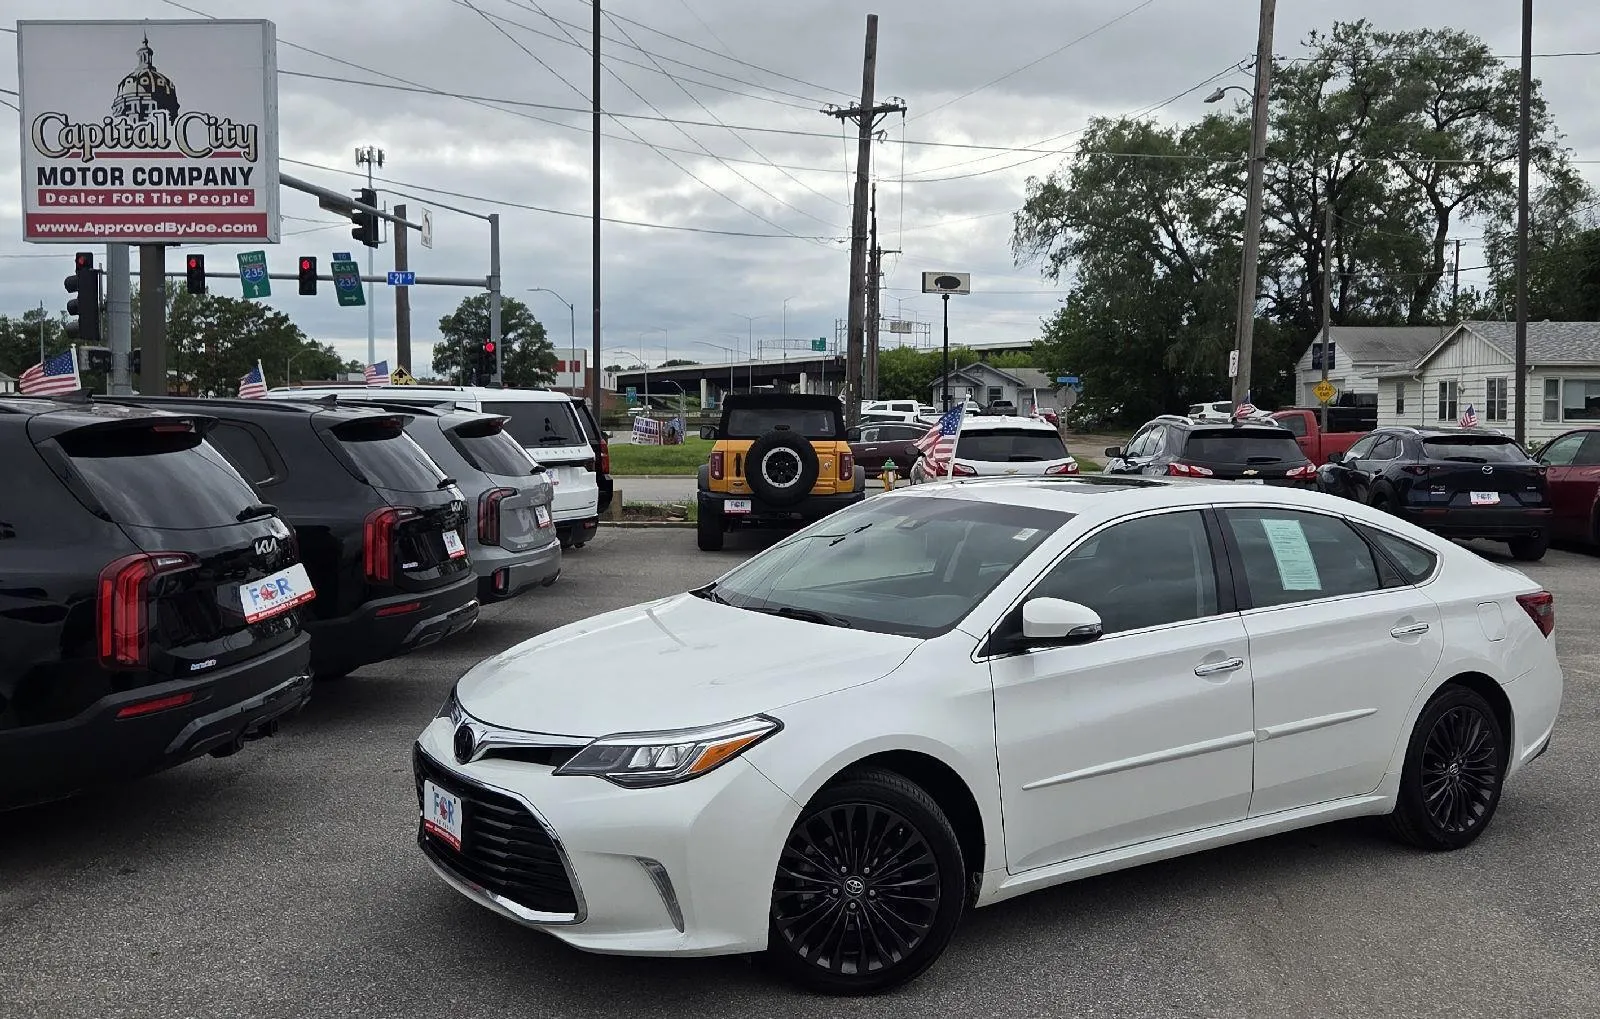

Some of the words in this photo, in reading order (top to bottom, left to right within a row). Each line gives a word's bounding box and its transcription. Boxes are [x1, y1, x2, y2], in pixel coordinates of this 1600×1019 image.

[32, 111, 171, 163] Capital
[175, 111, 258, 162] City
[37, 166, 124, 186] MOTOR
[132, 166, 254, 186] COMPANY
[45, 192, 105, 204] Dealer
[112, 193, 145, 204] FOR
[150, 193, 182, 204] The
[188, 192, 249, 206] People
[35, 222, 258, 235] www.ApprovedByJoe.com
[245, 268, 264, 278] 235
[340, 278, 357, 287] 235
